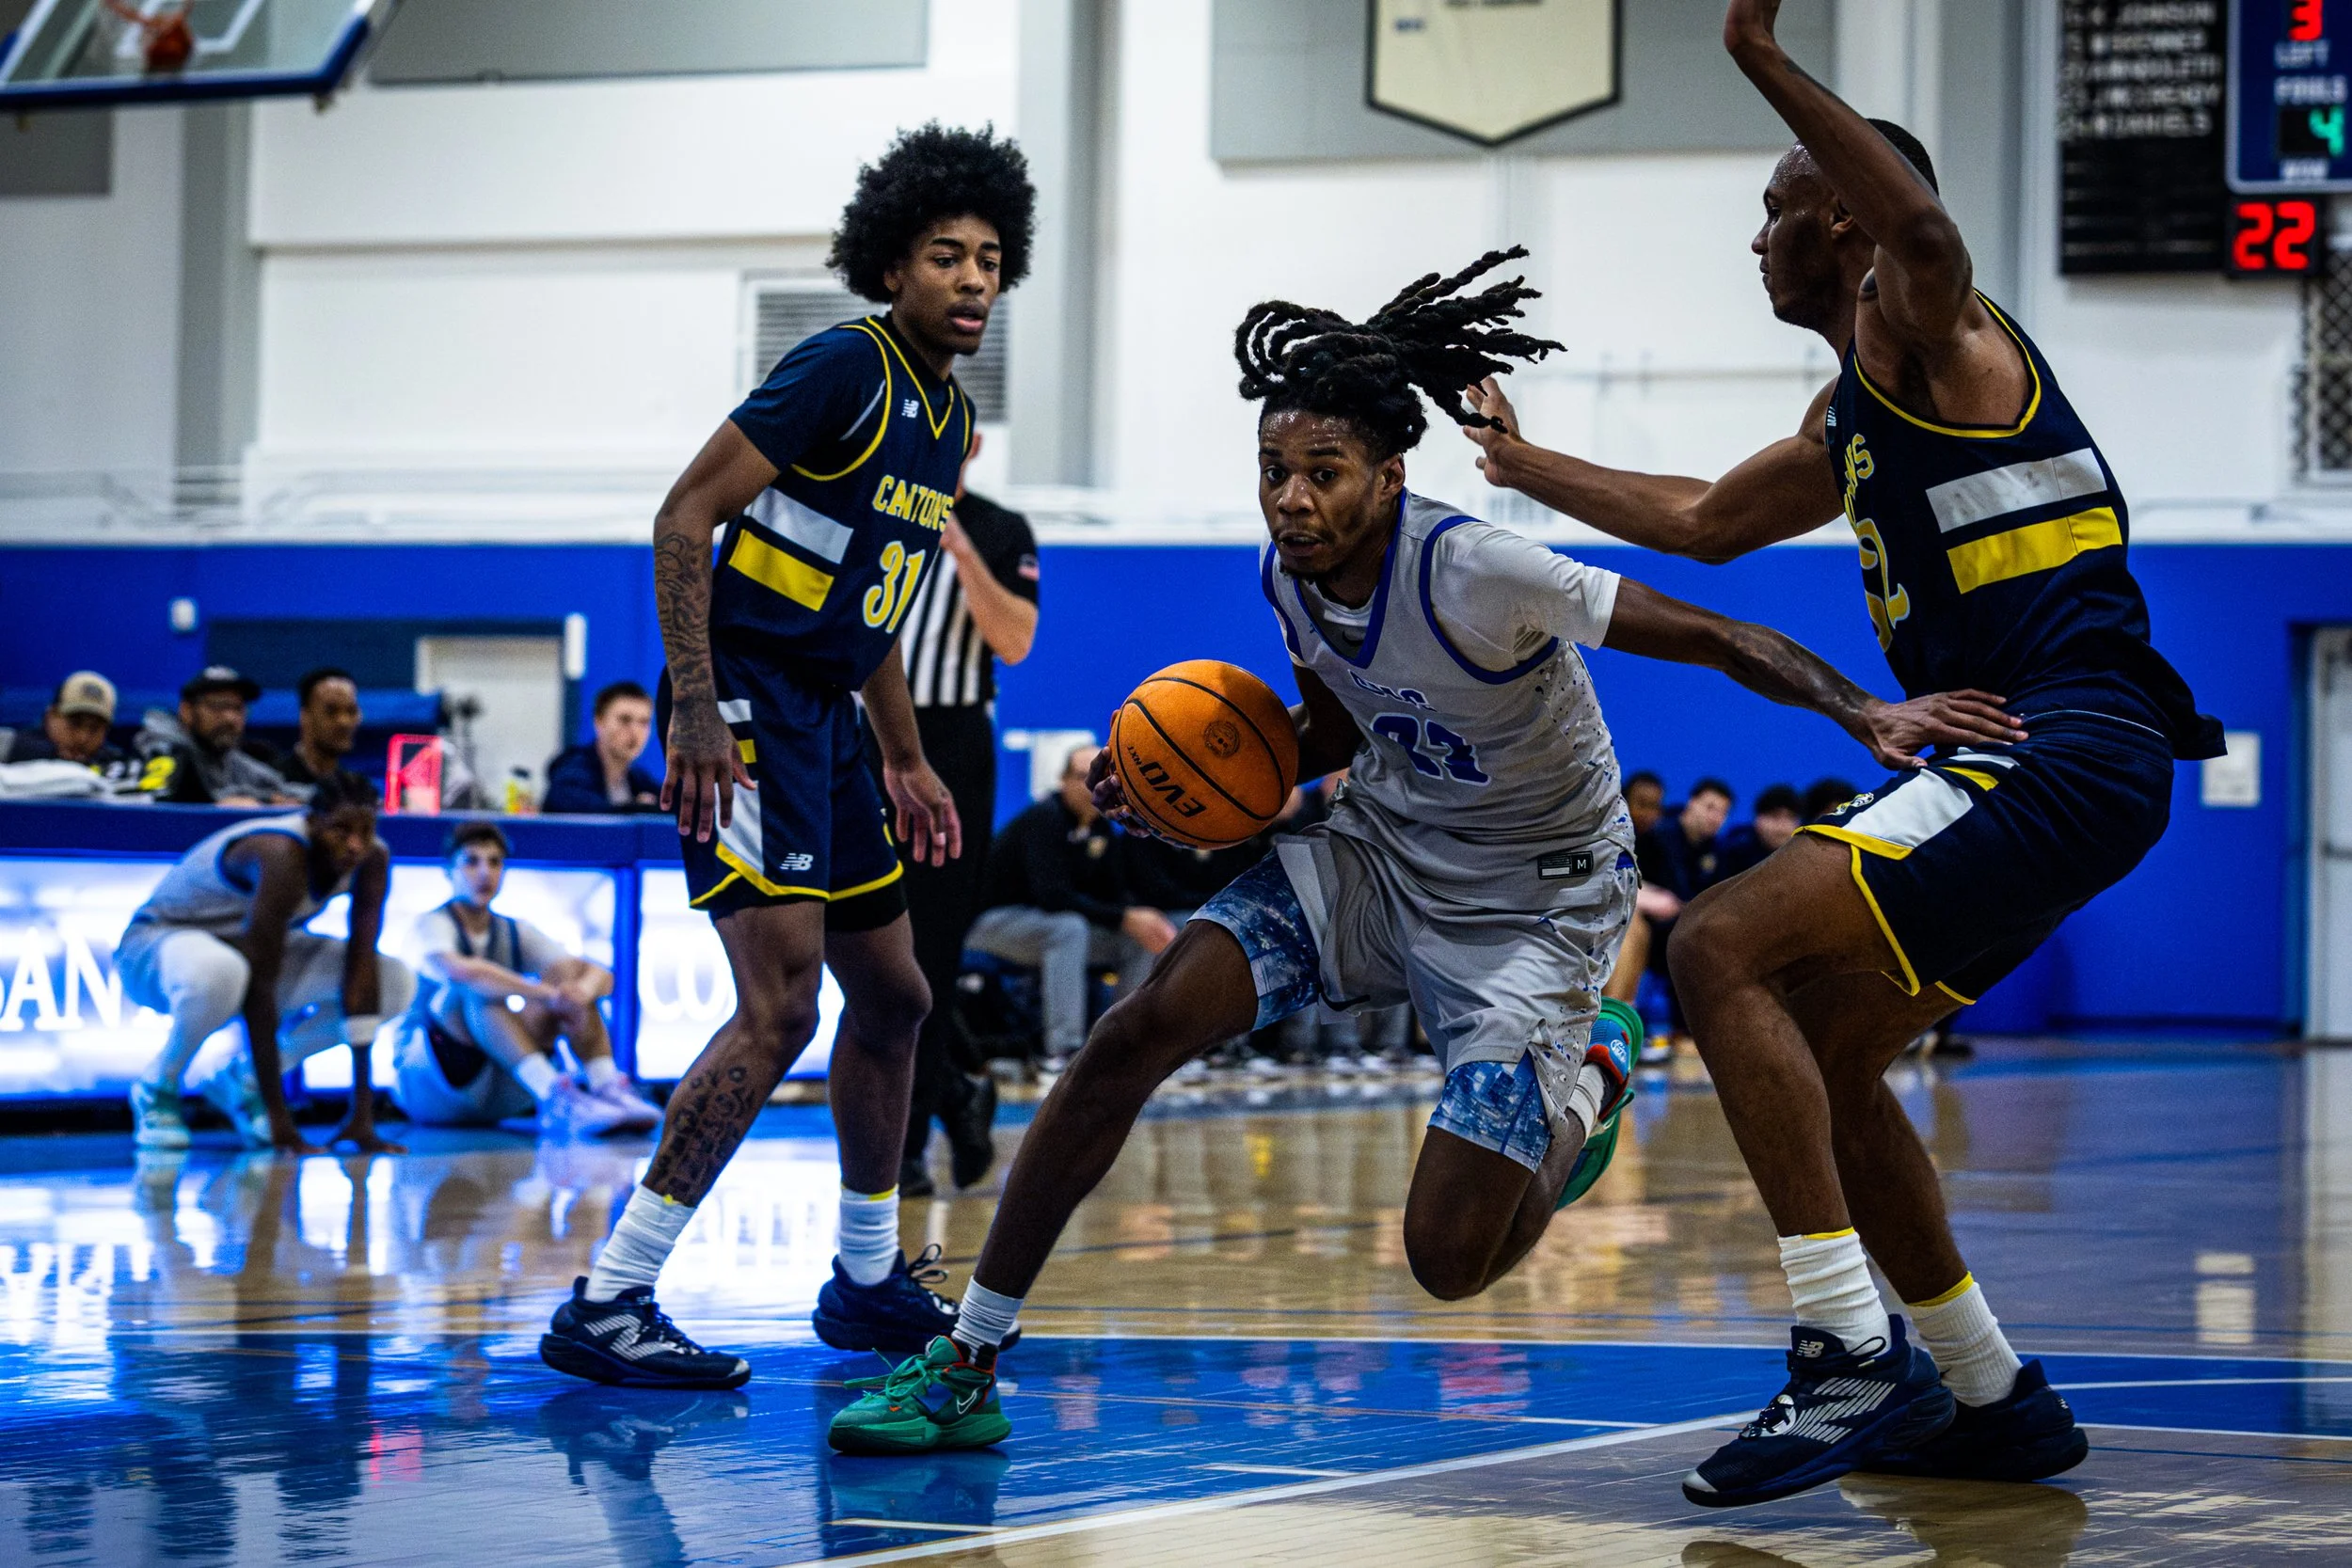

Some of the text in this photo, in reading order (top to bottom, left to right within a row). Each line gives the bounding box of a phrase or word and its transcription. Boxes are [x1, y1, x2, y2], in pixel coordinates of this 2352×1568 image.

[2309, 104, 2344, 156] 4
[2233, 200, 2315, 270] 22
[863, 541, 926, 634] 31
[1139, 761, 1207, 818] EVO
[1577, 858, 1587, 870] M
